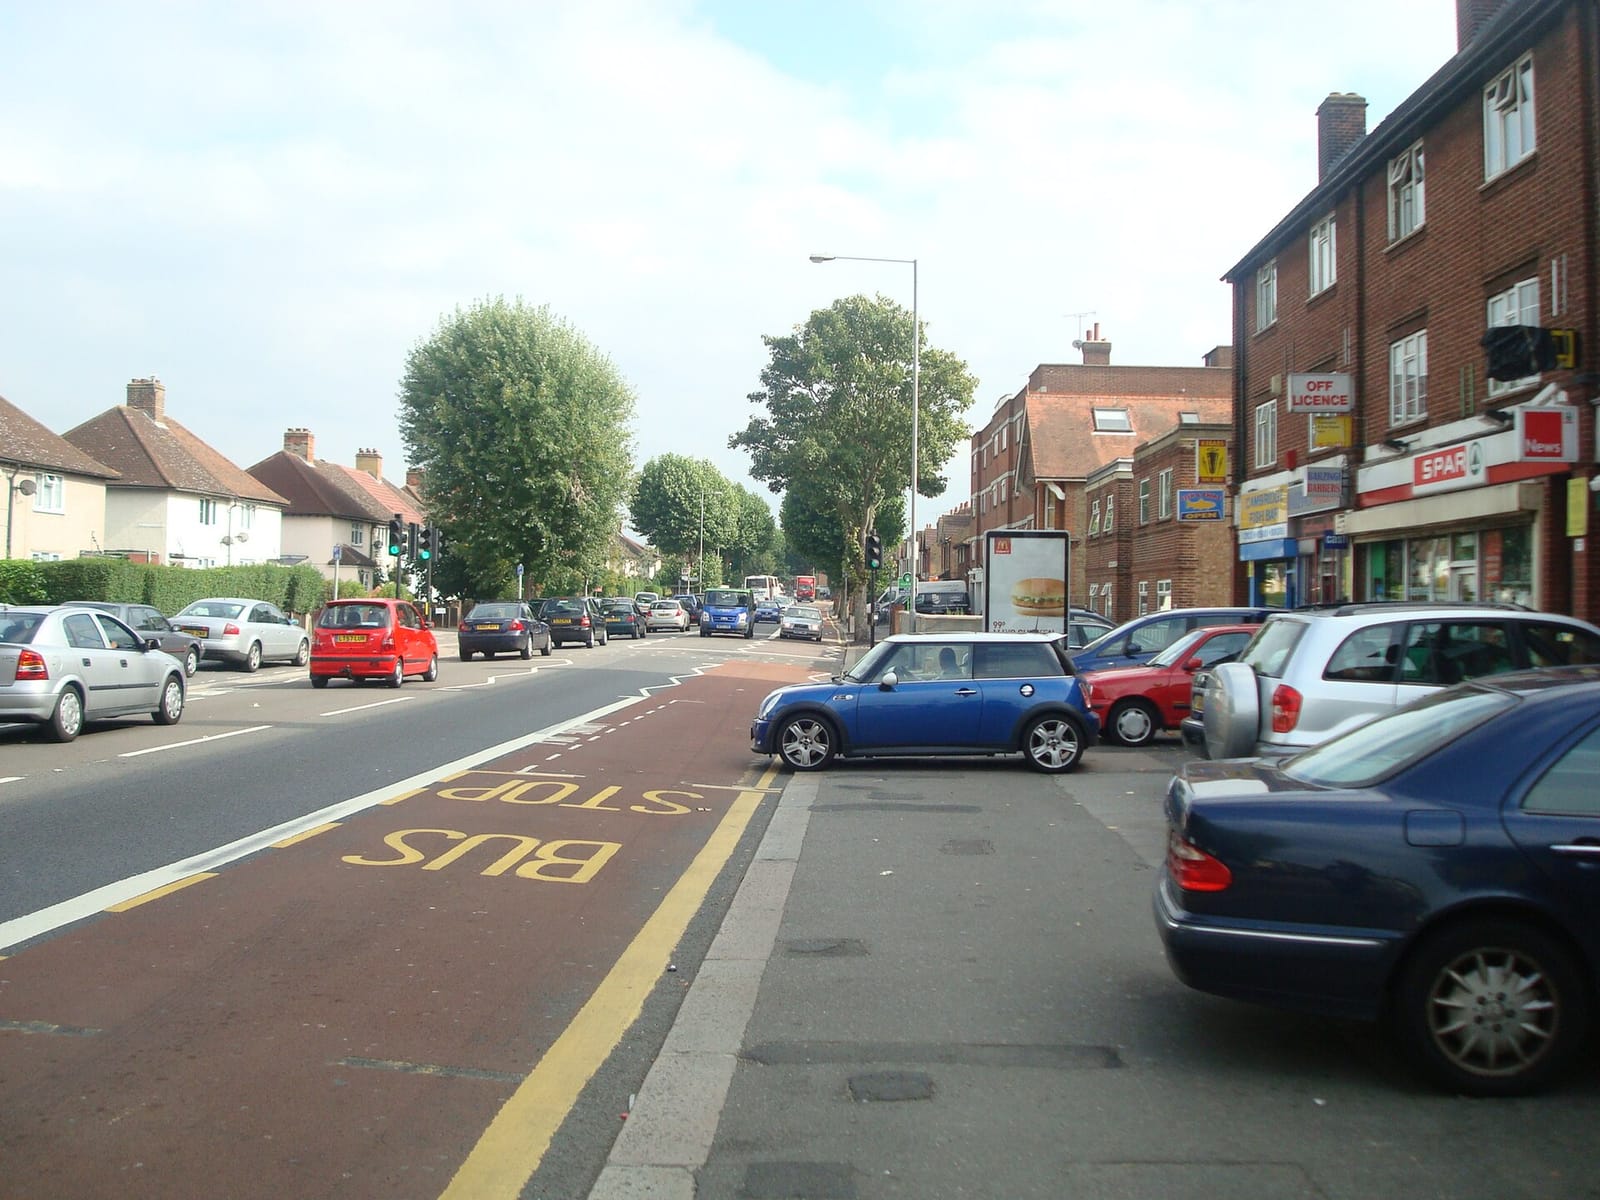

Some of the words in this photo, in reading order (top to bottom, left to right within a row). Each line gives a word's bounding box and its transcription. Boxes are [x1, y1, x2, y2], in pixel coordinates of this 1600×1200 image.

[1306, 380, 1333, 392] OFF
[1292, 395, 1349, 406] LICENCE
[1525, 438, 1561, 453] News
[1421, 451, 1466, 480] SPAR
[1185, 511, 1217, 519] OPEN
[437, 779, 704, 815] STOP
[341, 829, 622, 884] BUS
